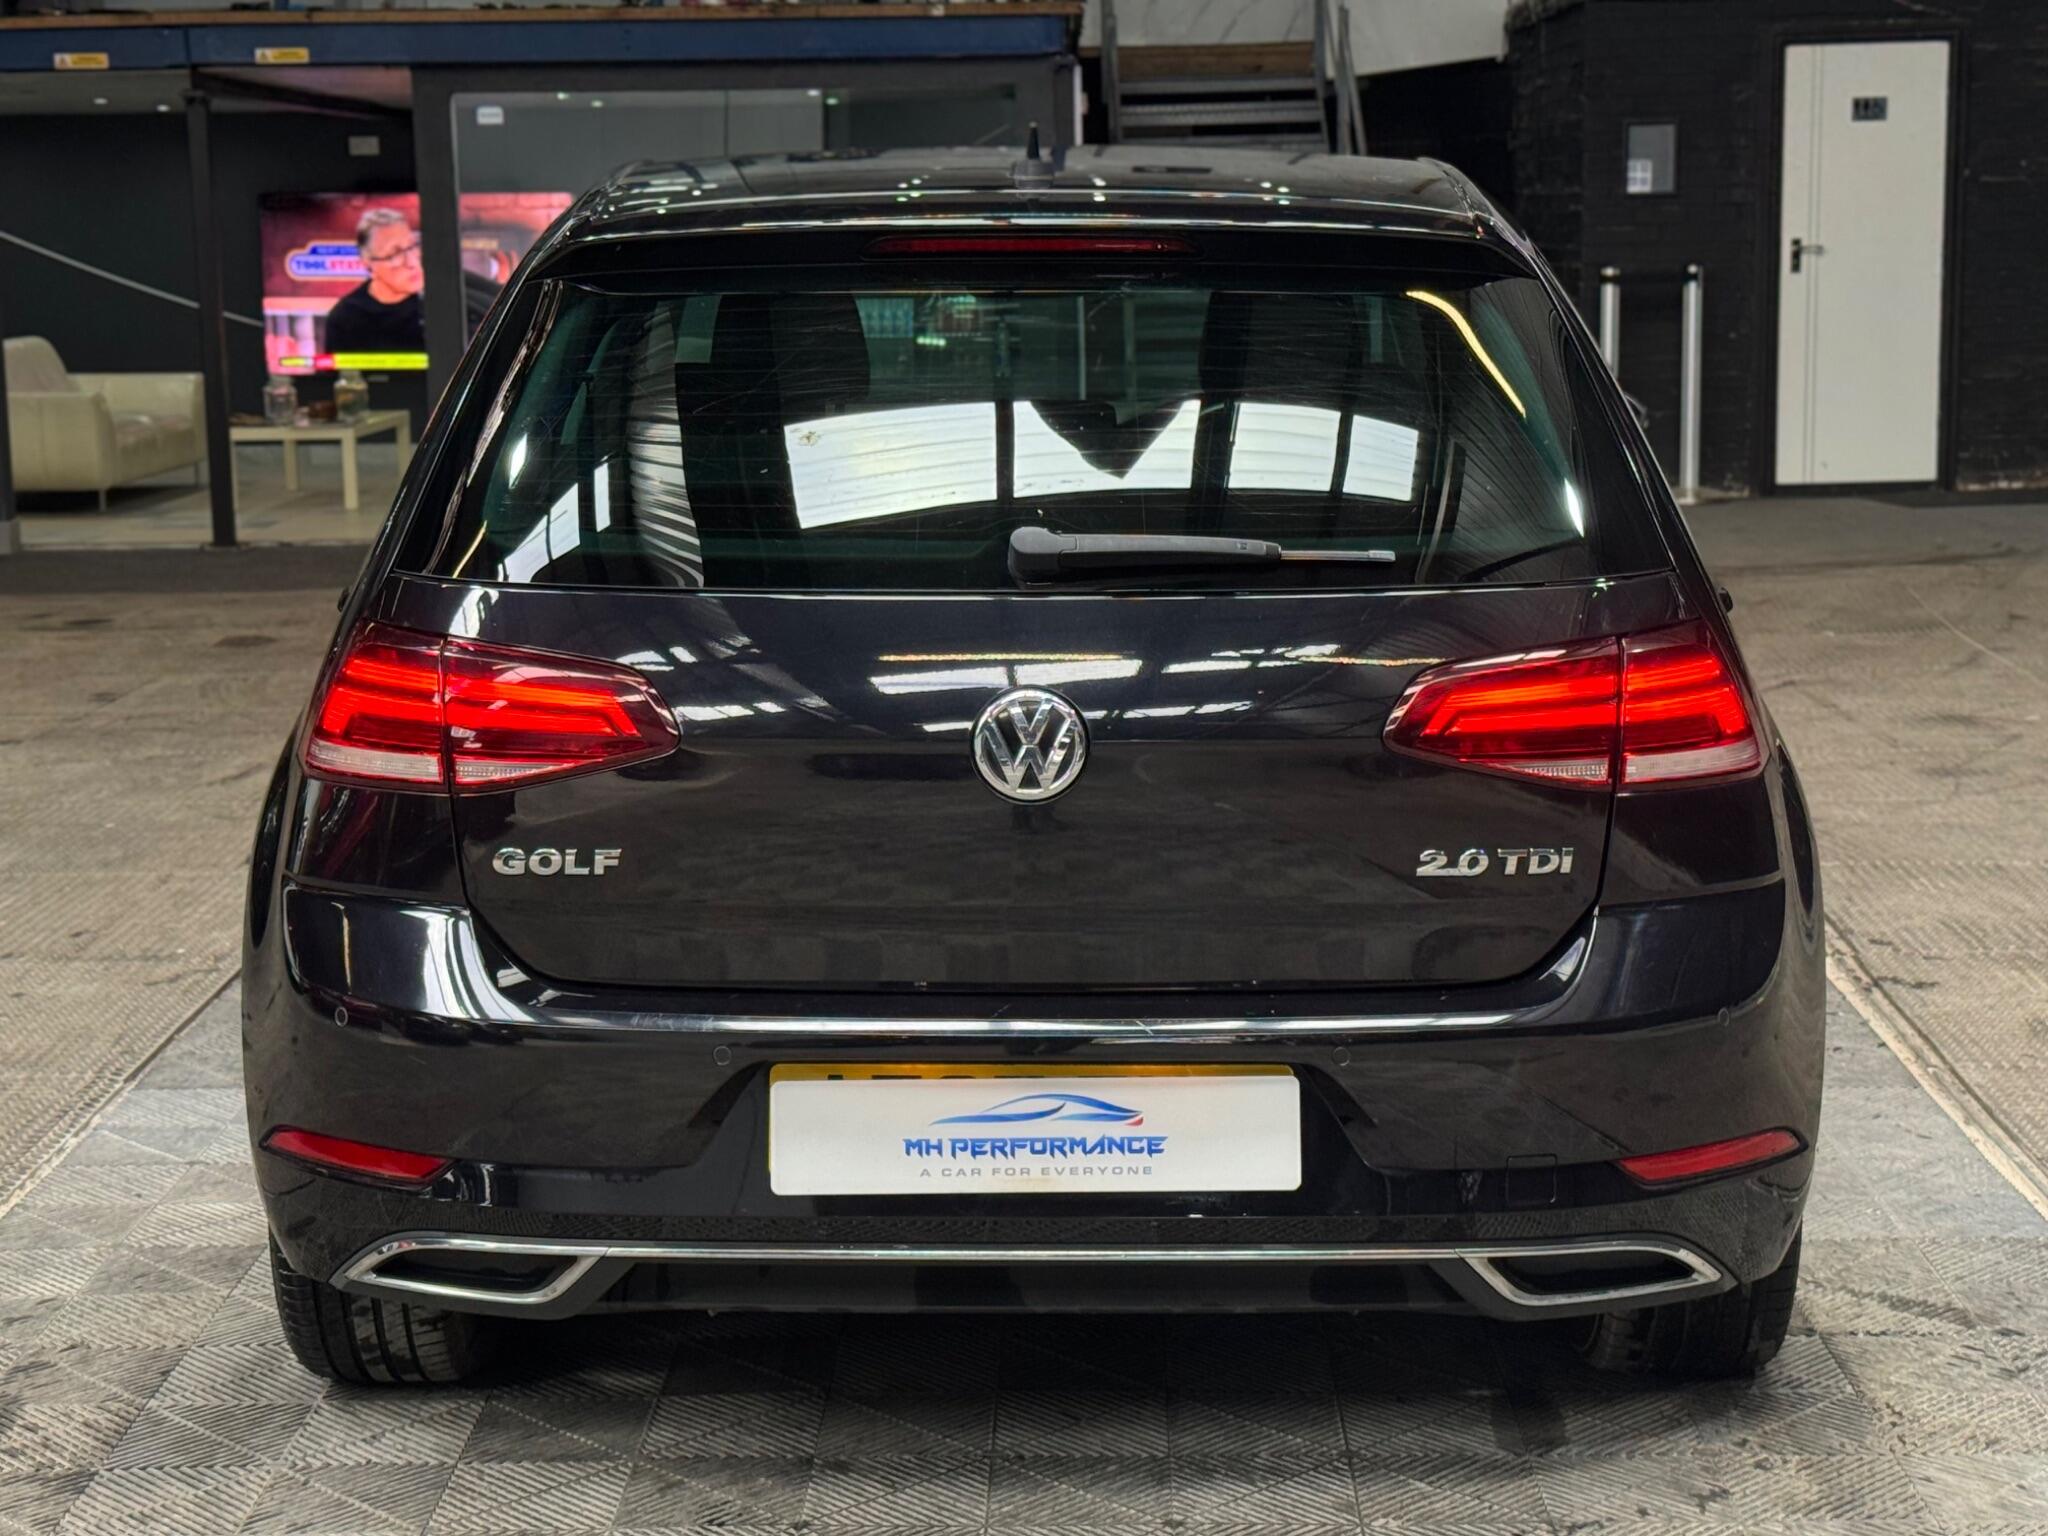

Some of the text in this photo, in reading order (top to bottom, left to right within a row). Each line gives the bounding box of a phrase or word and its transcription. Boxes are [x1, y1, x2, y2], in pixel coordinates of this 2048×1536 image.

[492, 847, 622, 876] GOLF
[1416, 847, 1574, 876] 2.0 TDI
[902, 1134, 1168, 1160] MH PERFORMANCE
[920, 1165, 1153, 1177] A CAR FOR EVERYONE
